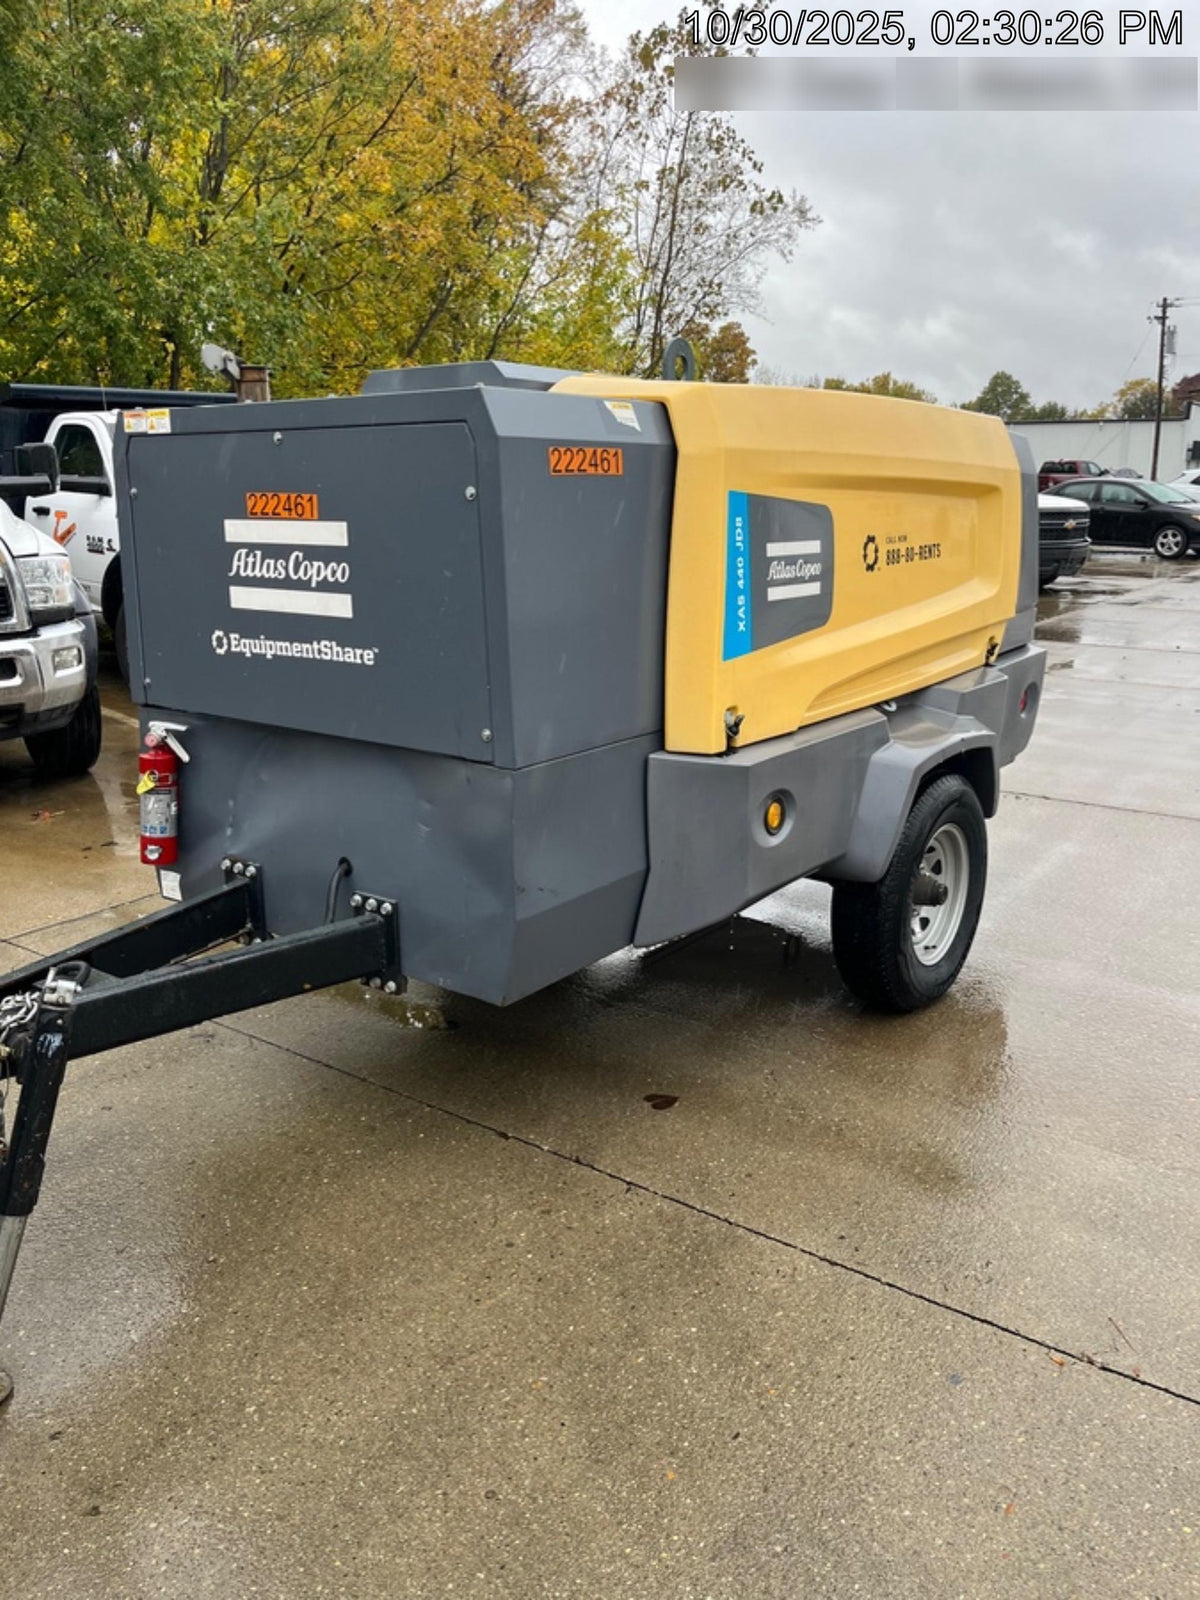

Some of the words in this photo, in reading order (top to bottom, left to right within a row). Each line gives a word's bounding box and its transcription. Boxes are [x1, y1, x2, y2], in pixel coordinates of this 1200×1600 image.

[550, 447, 620, 474] 222461
[247, 493, 316, 518] 222461
[228, 548, 287, 580] Atlas
[289, 550, 350, 588] Copco
[736, 556, 745, 590] 440
[766, 560, 795, 581] Atlas
[796, 559, 822, 580] Copco
[737, 595, 746, 633] XAS
[229, 633, 376, 666] EquipmentShare
